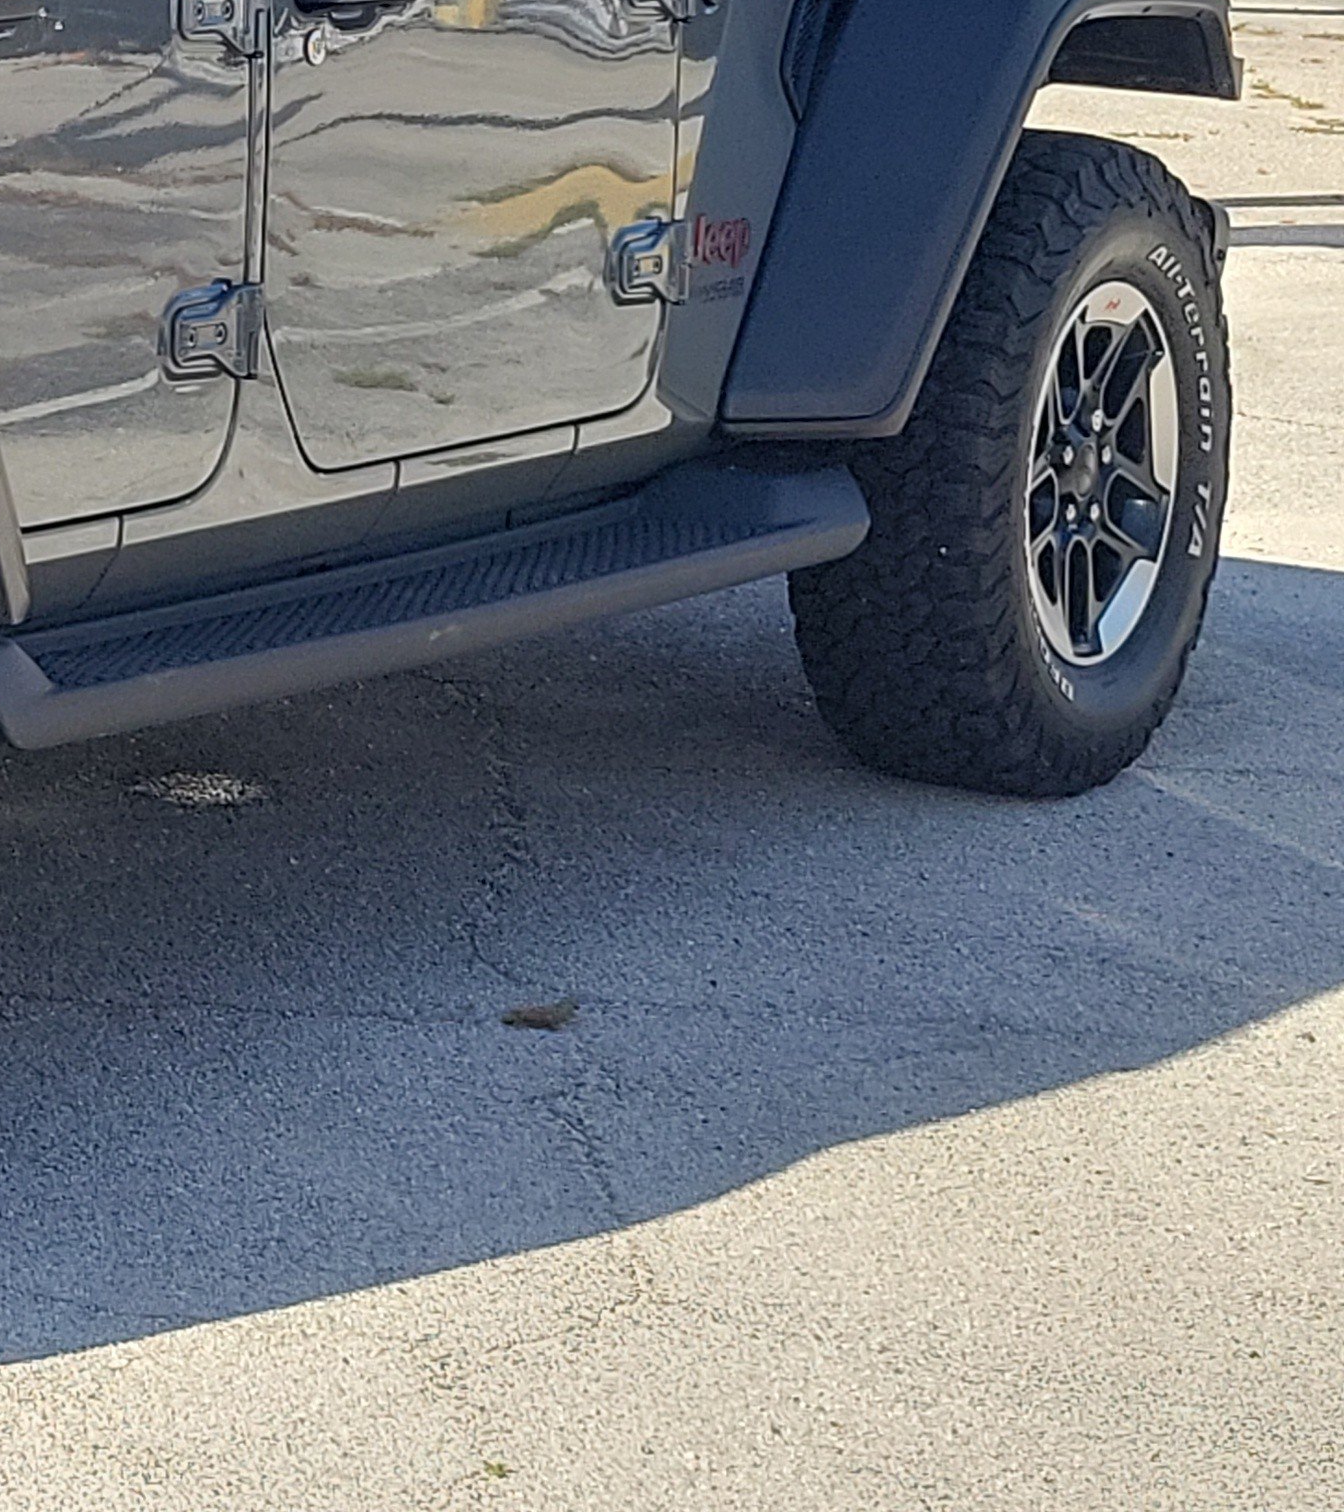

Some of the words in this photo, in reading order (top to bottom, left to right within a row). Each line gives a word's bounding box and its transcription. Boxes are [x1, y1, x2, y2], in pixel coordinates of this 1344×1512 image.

[693, 212, 751, 269] Jeep
[1147, 243, 1214, 454] All-Terrain
[1187, 481, 1214, 558] T/A
